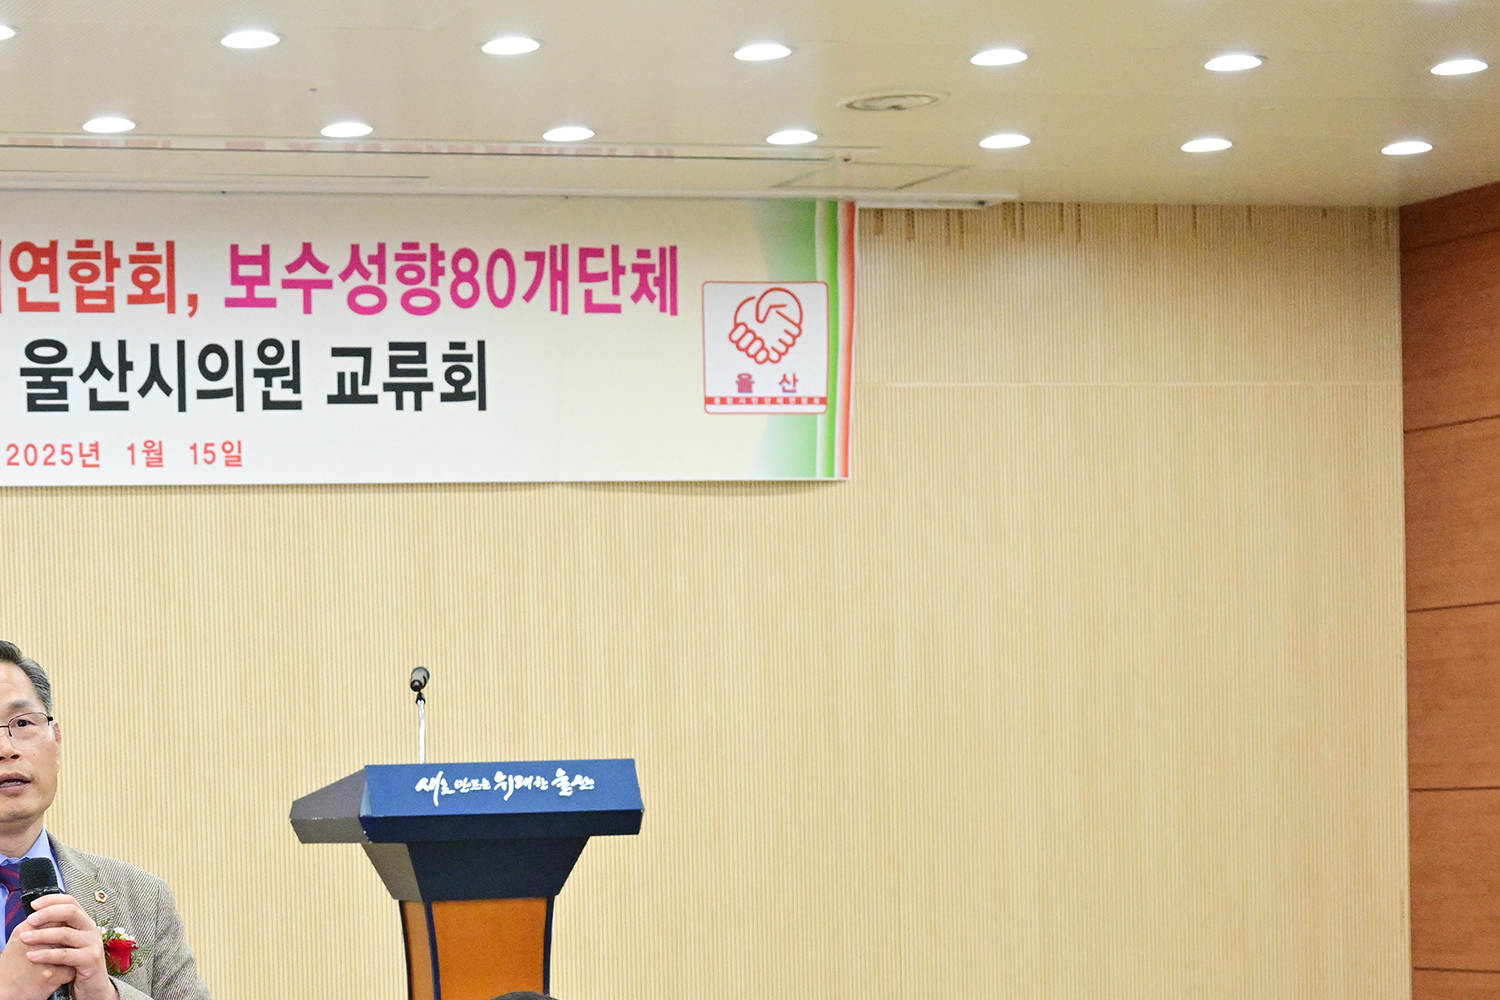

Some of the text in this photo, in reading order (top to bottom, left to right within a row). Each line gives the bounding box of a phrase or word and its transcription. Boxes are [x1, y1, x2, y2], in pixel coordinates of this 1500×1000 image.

[224, 241, 680, 318] 보수성향80개단체
[19, 338, 303, 413] 울산시의원
[326, 340, 488, 412] 교류회
[6, 439, 243, 468] 2025년 1월 15일
[415, 768, 595, 807] 새로 만드는 위대한 울산
